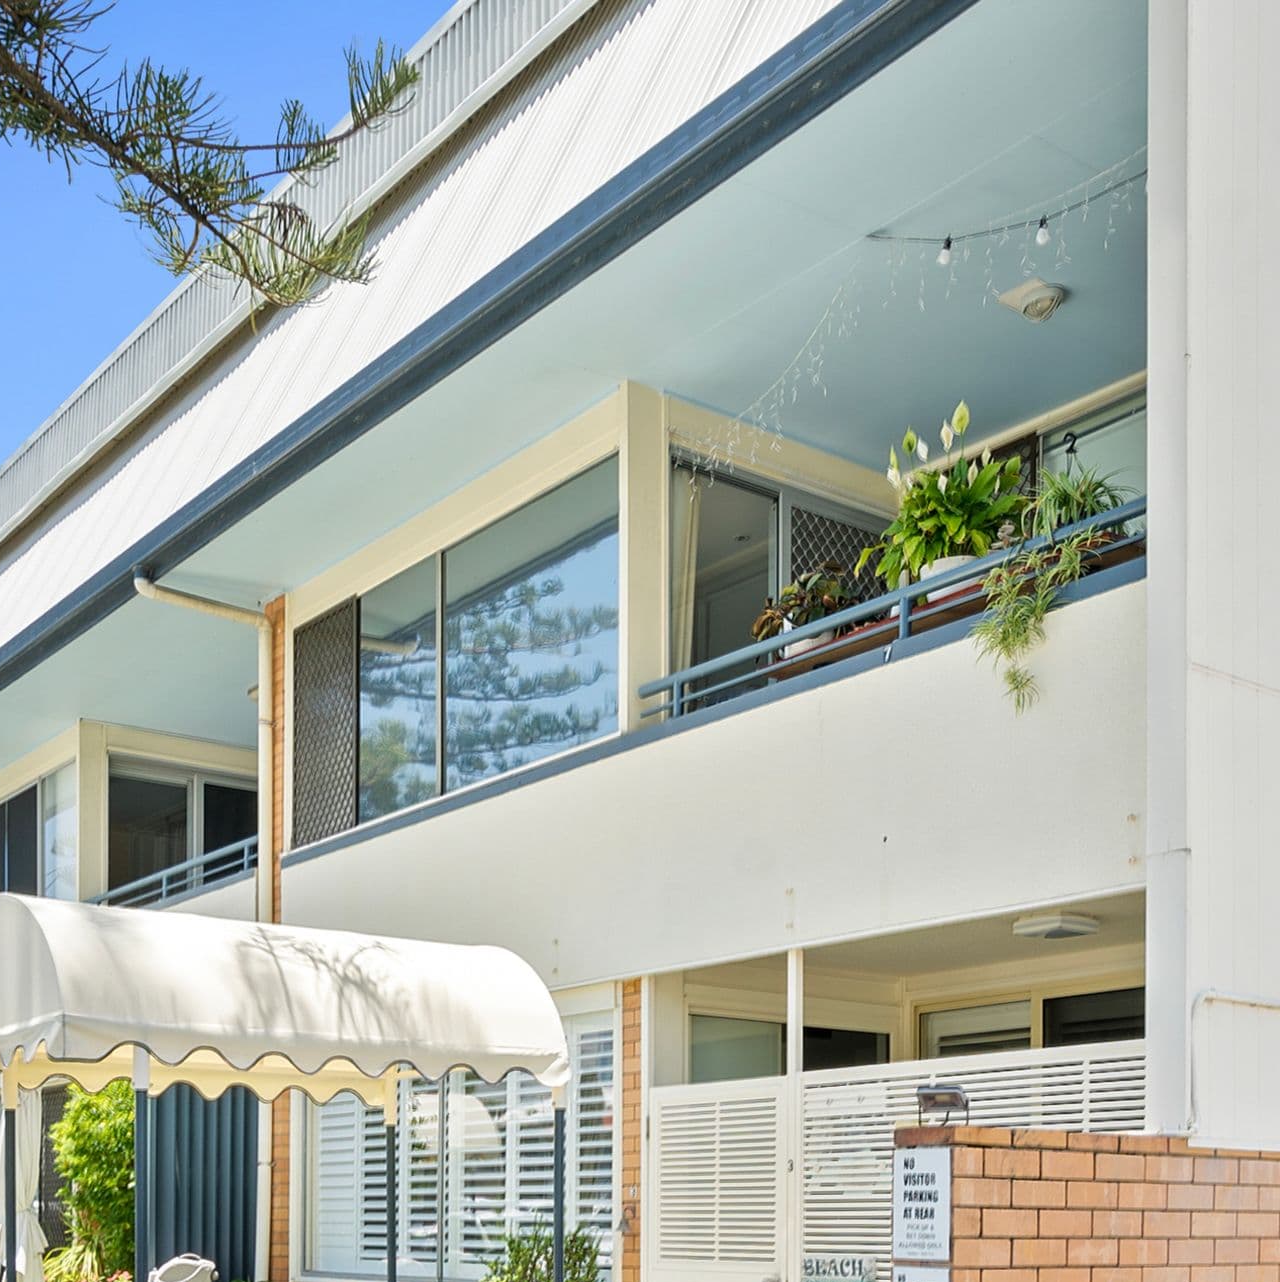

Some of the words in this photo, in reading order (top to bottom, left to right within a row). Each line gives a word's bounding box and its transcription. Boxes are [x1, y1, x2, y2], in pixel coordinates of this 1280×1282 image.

[903, 1157, 915, 1170] NO
[903, 1173, 936, 1186] VISITOR
[903, 1190, 939, 1203] PARKING
[903, 1206, 912, 1219] AT
[914, 1206, 935, 1220] REAR
[803, 1257, 863, 1277] BEACH
